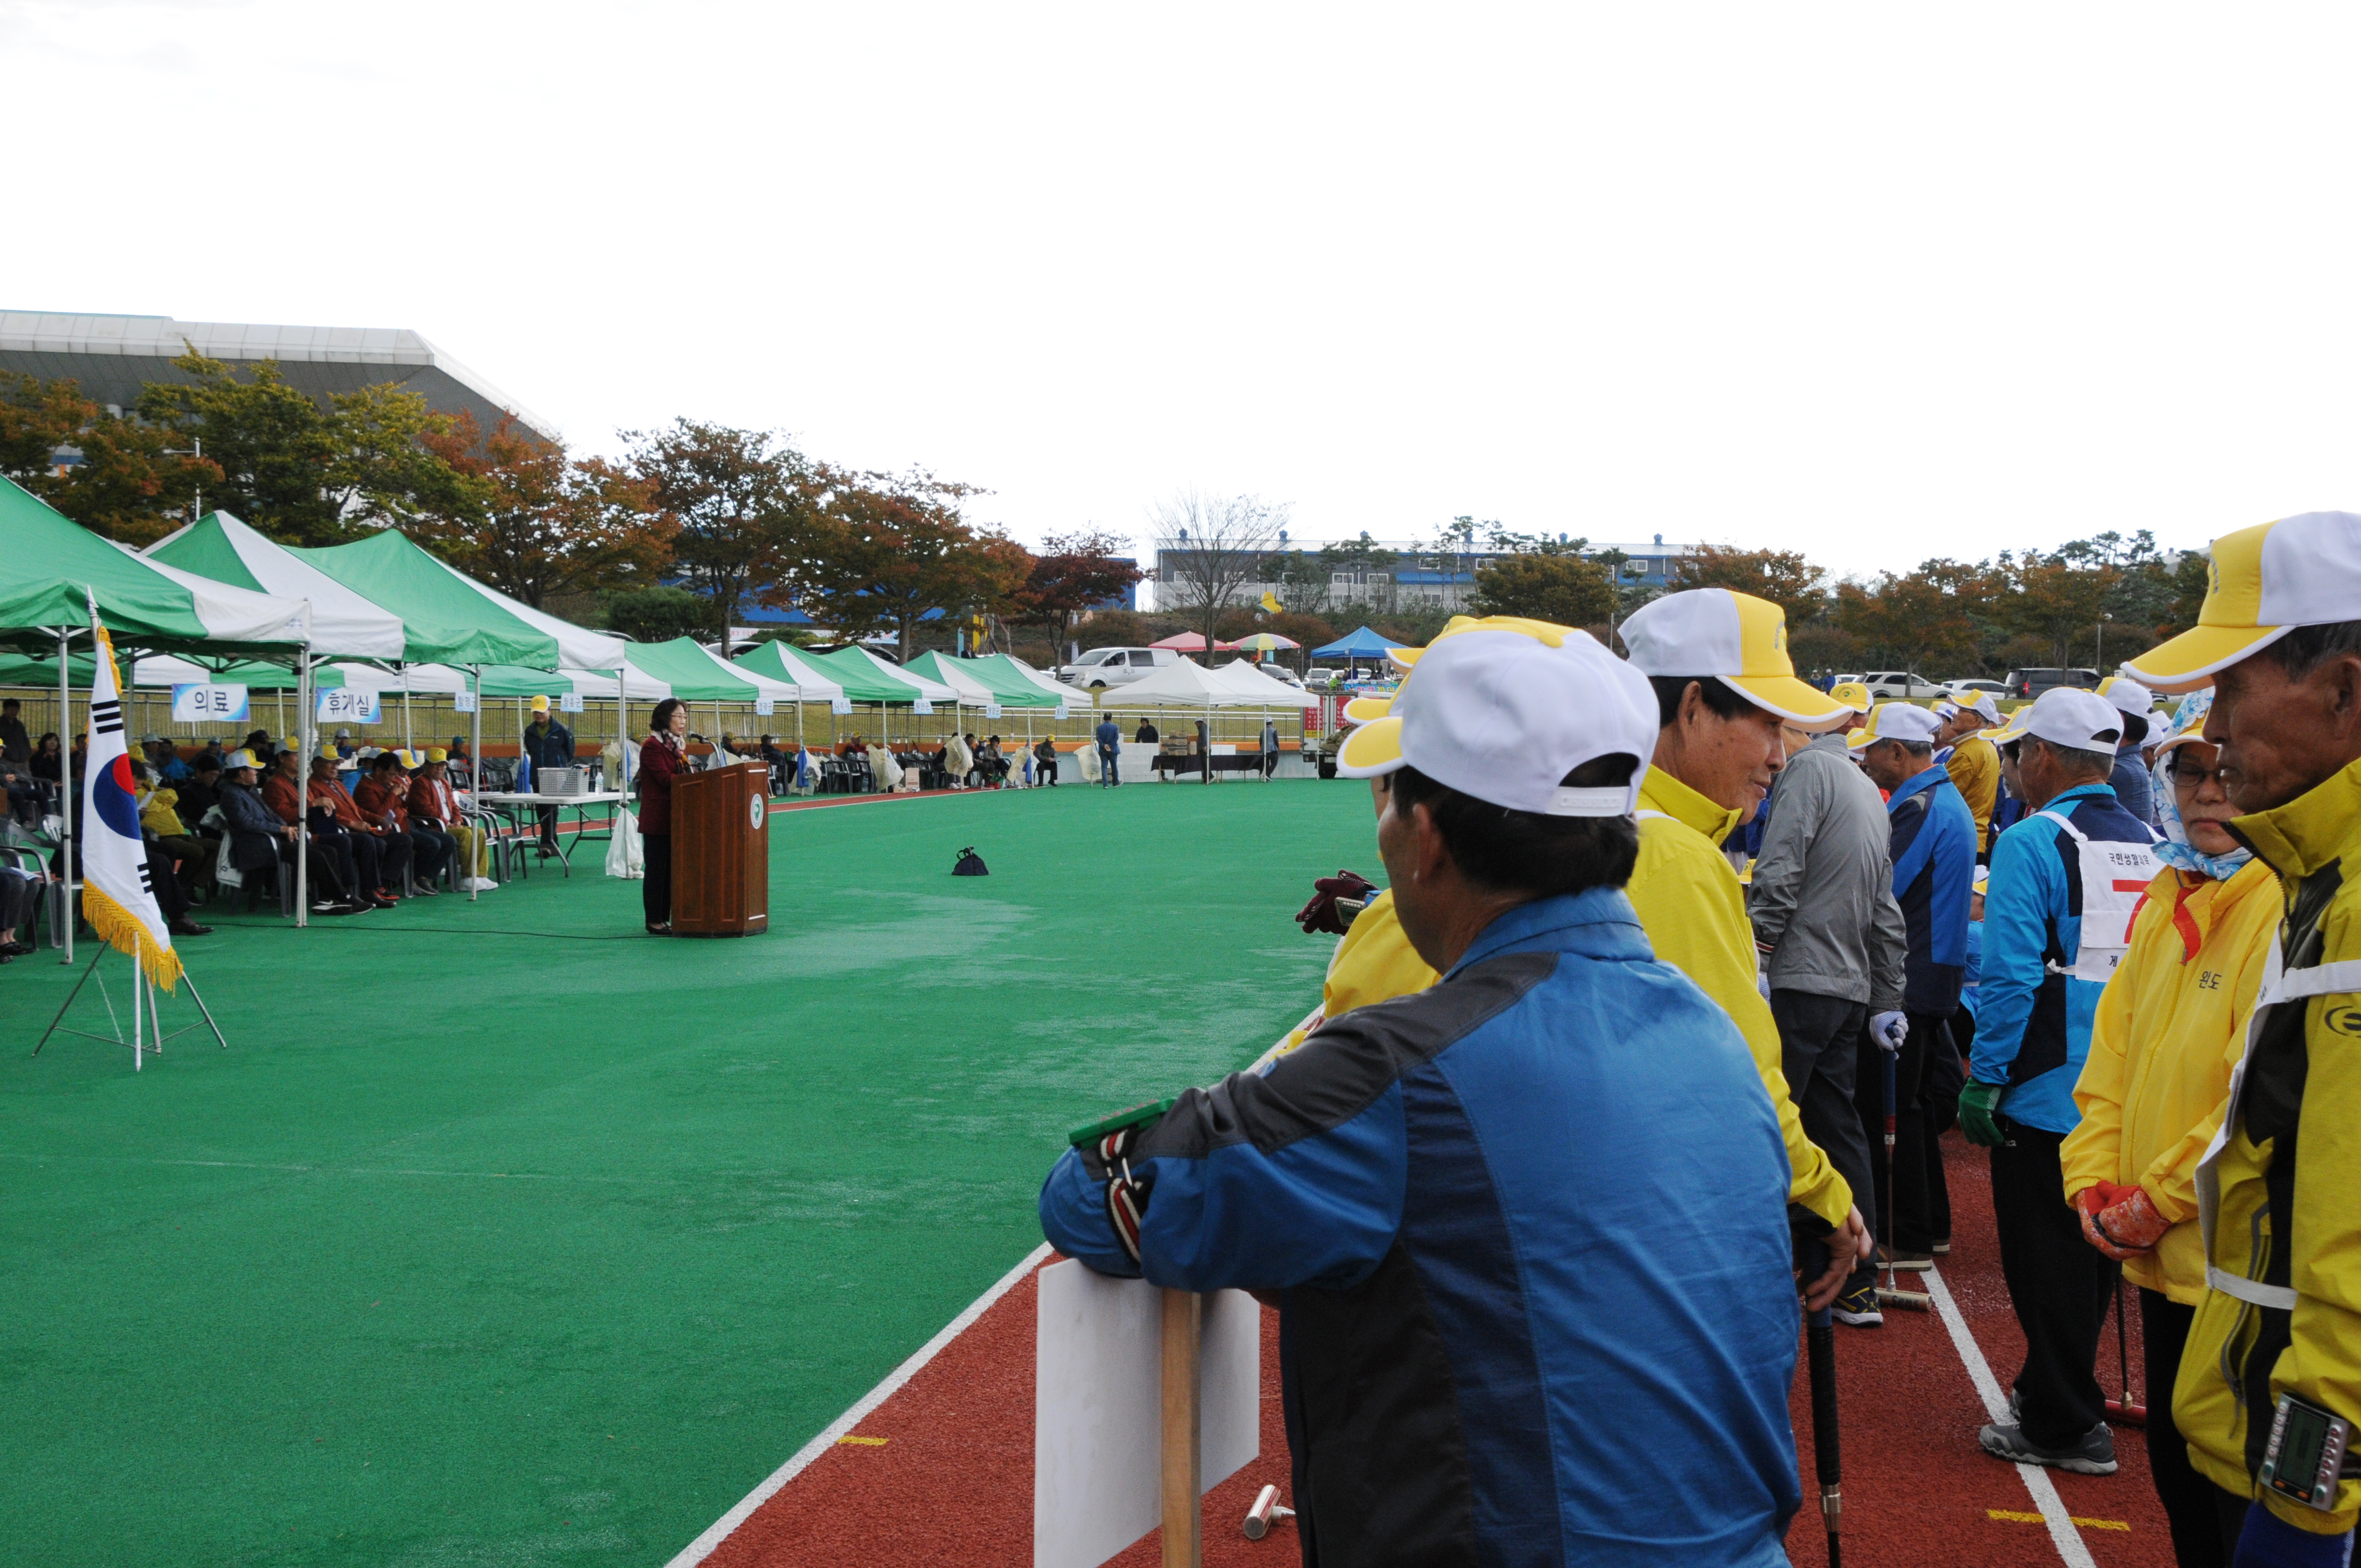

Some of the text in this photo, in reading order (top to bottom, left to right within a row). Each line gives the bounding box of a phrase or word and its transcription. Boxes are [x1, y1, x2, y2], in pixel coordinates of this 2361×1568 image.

[194, 689, 230, 713] 의료
[328, 693, 370, 716] 휴게실
[834, 701, 849, 710] 나주시
[2199, 971, 2222, 990] 완도
